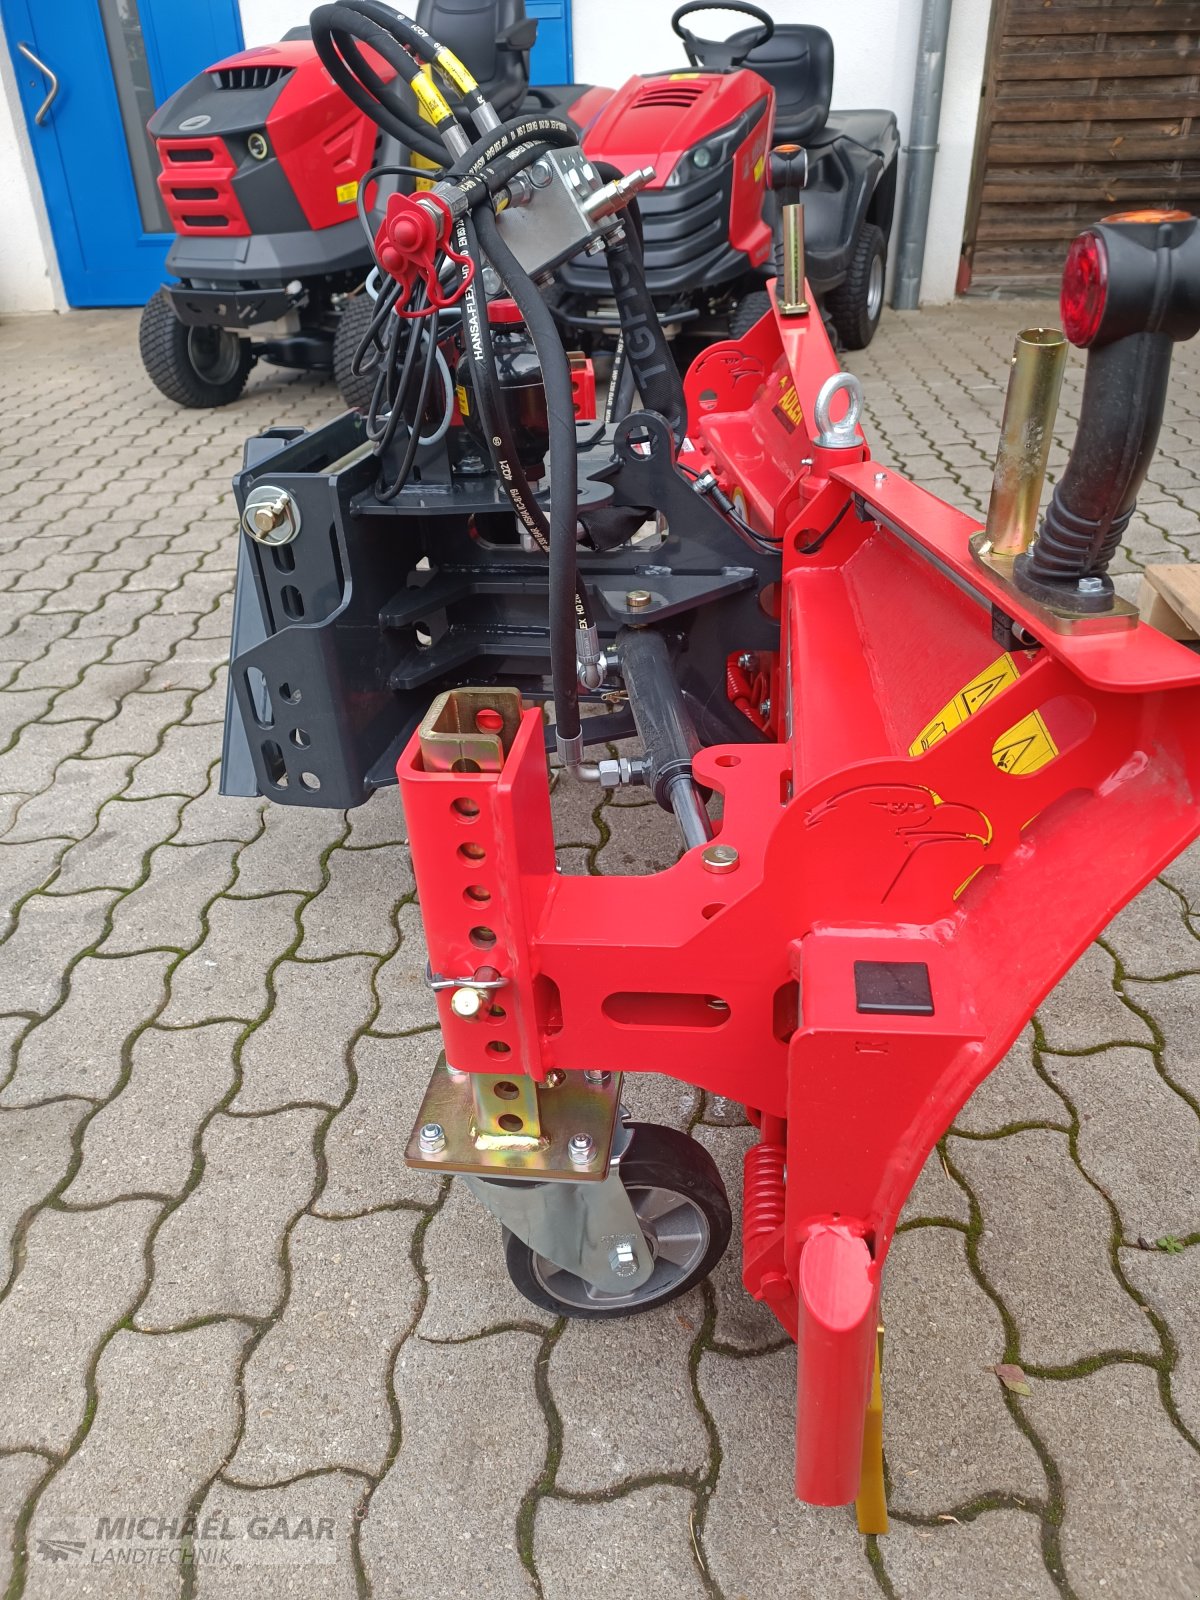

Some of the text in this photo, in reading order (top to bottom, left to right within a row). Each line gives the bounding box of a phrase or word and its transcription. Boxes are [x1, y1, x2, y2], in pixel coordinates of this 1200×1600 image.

[458, 237, 467, 247] EN
[465, 284, 484, 360] HANSA-FLEX
[499, 460, 513, 480] 4Q21
